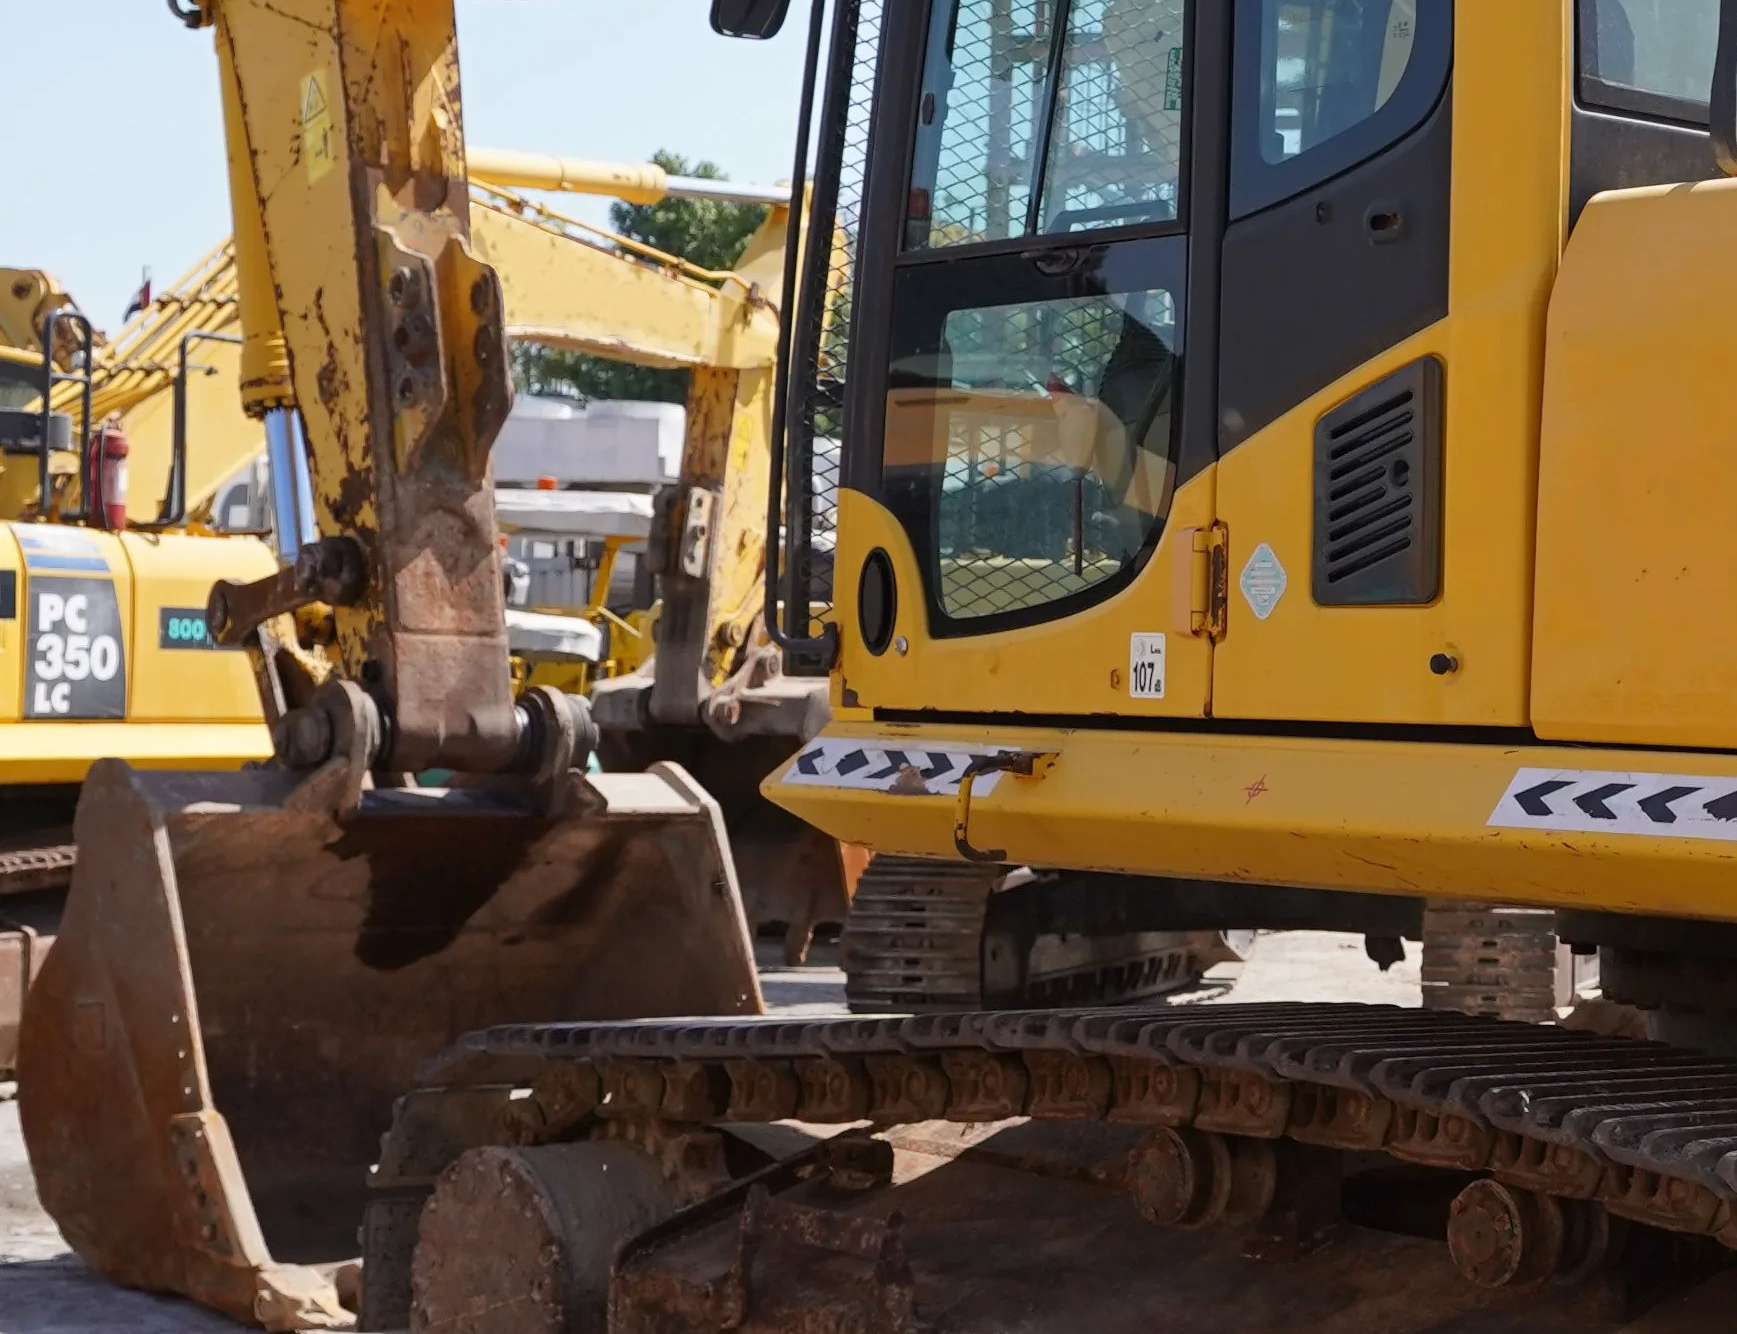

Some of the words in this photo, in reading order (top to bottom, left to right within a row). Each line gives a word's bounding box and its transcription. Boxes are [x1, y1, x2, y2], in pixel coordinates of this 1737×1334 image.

[38, 592, 88, 633] PC
[168, 617, 207, 640] 800
[34, 633, 120, 681] 350
[1133, 661, 1155, 692] 107
[33, 682, 71, 714] LC
